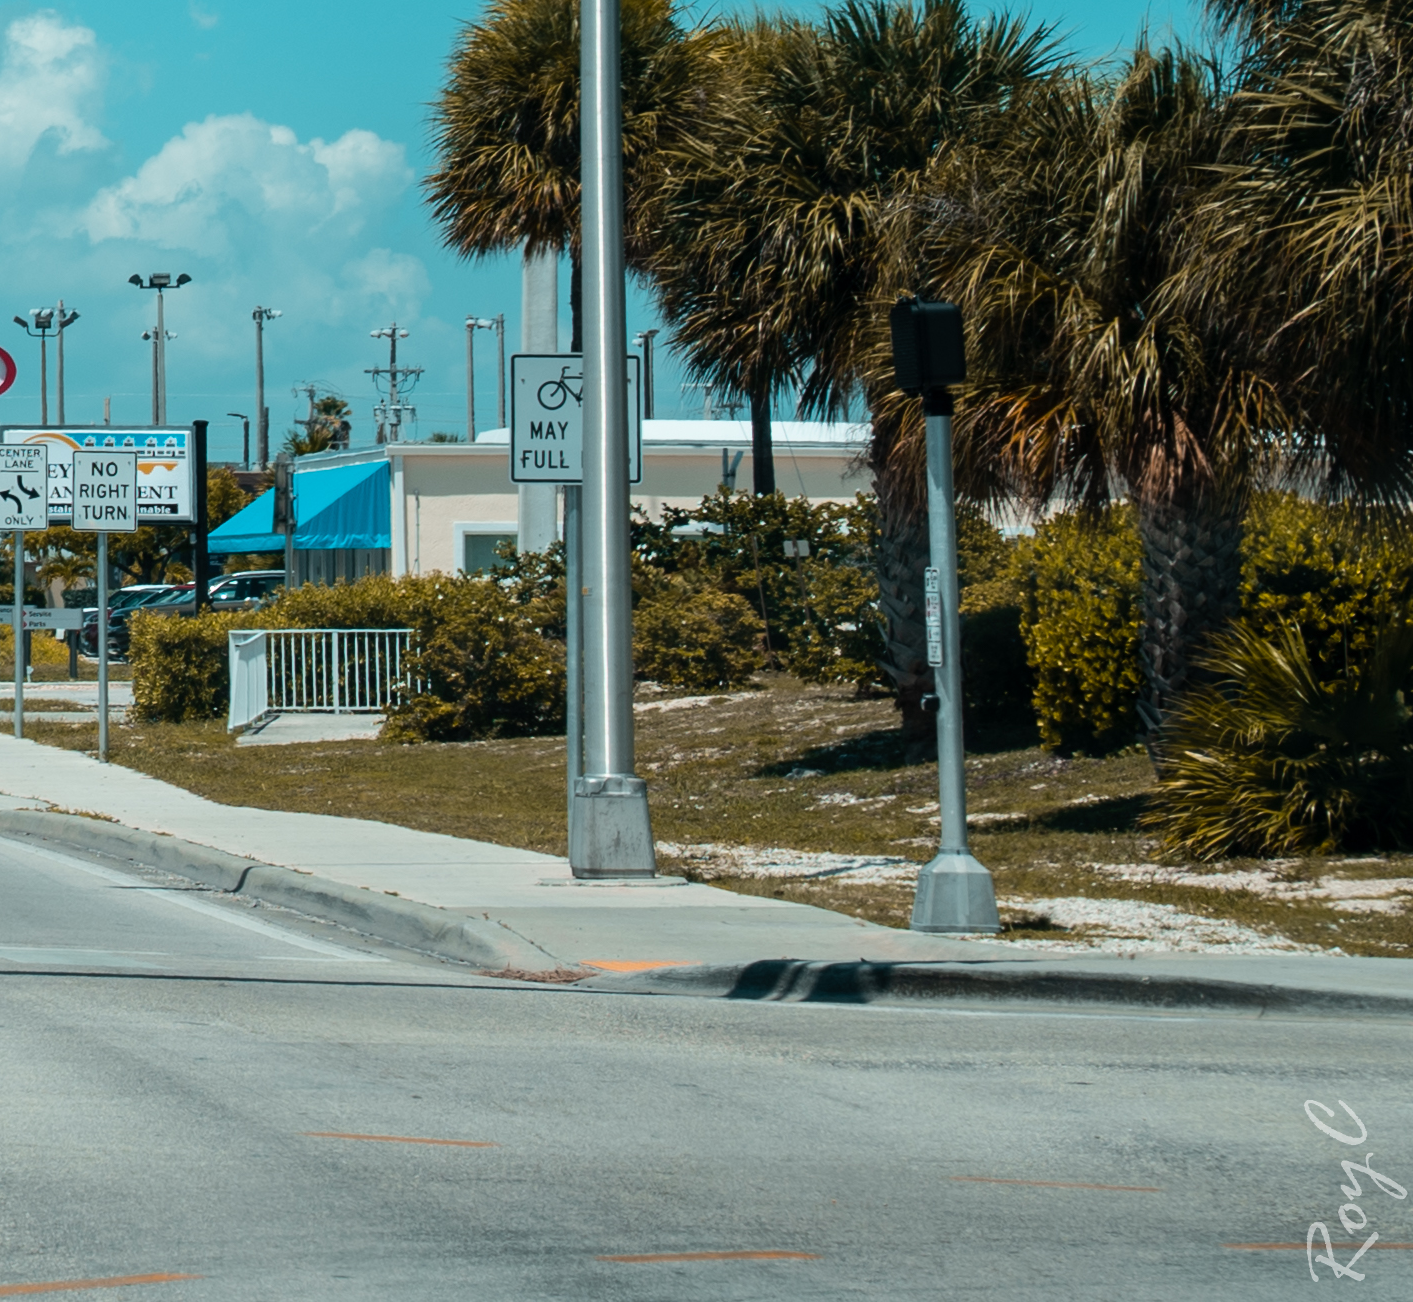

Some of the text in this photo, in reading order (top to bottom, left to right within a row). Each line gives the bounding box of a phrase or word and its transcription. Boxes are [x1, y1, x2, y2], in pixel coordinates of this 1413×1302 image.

[530, 421, 569, 439] MAY
[0, 448, 41, 458] CENTER
[521, 450, 570, 469] FULL
[4, 459, 34, 469] LANE
[48, 463, 73, 479] EY
[91, 461, 119, 477] NO
[79, 483, 130, 499] RIGHT
[4, 516, 34, 526] ONLY
[82, 505, 128, 521] TURN
